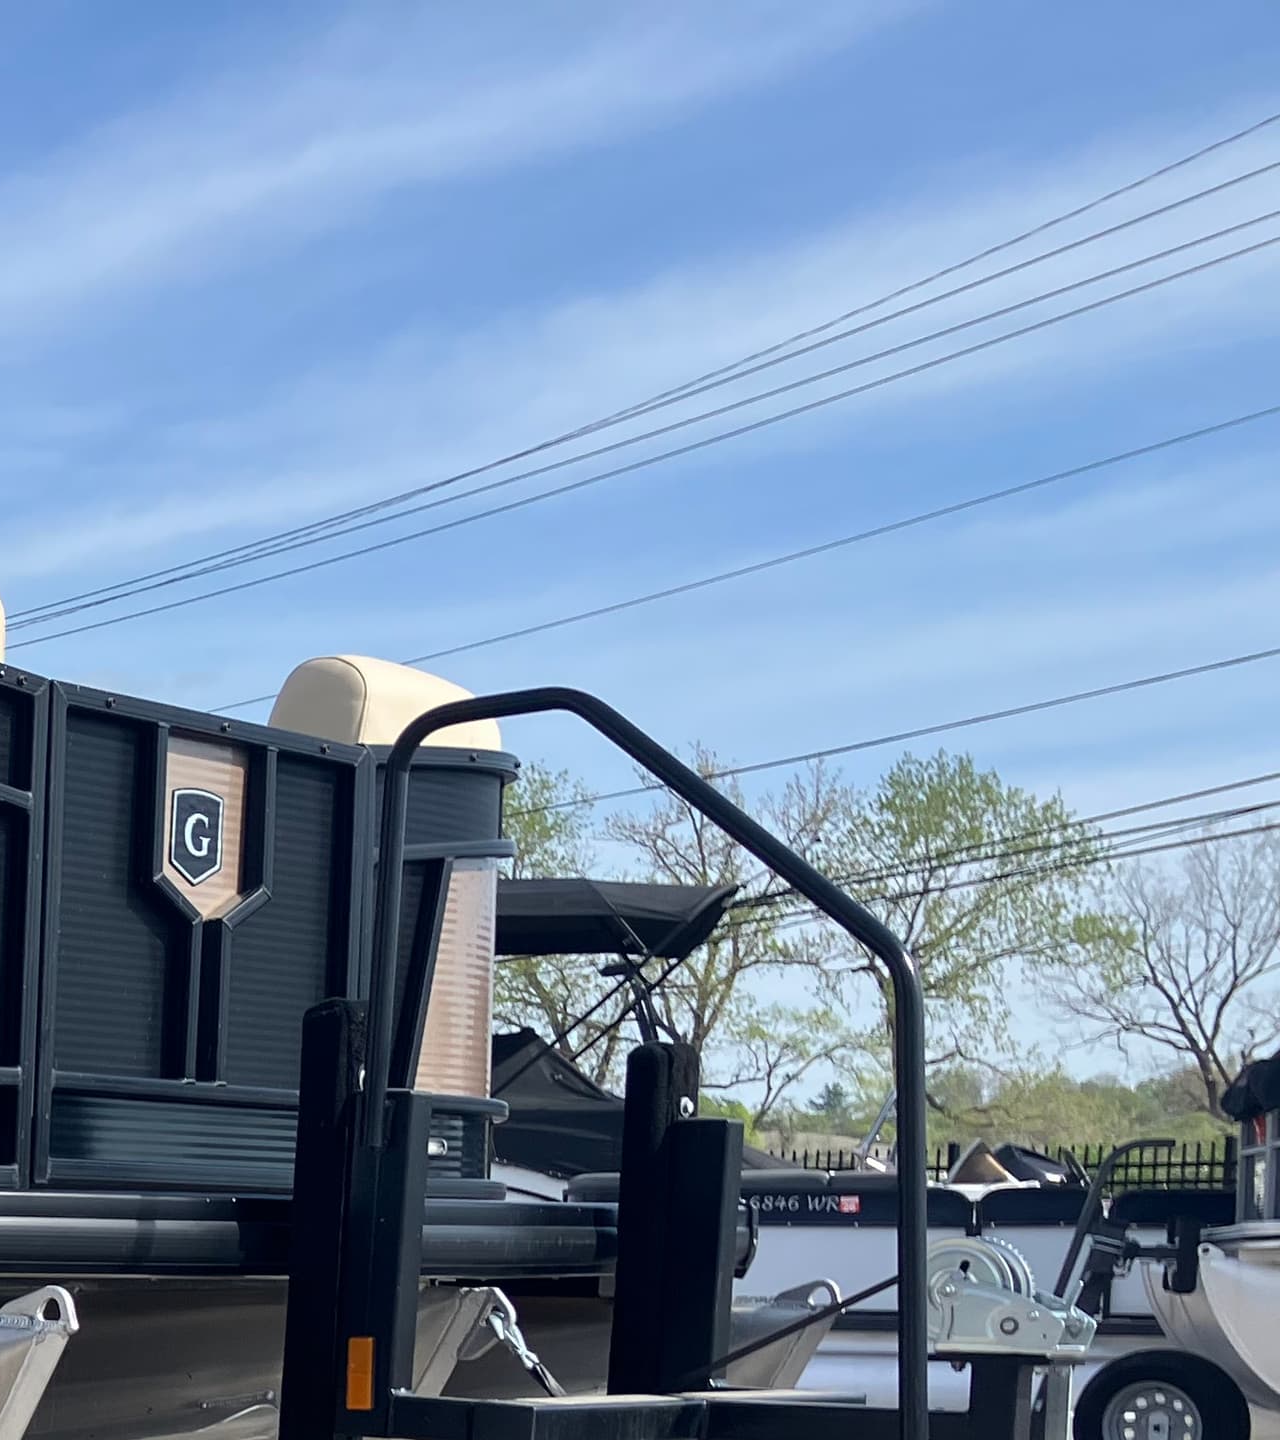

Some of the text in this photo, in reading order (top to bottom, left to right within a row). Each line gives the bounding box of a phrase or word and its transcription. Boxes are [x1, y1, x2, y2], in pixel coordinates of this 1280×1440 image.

[184, 813, 211, 857] G
[749, 1194, 800, 1212] 6846
[807, 1194, 840, 1212] WR
